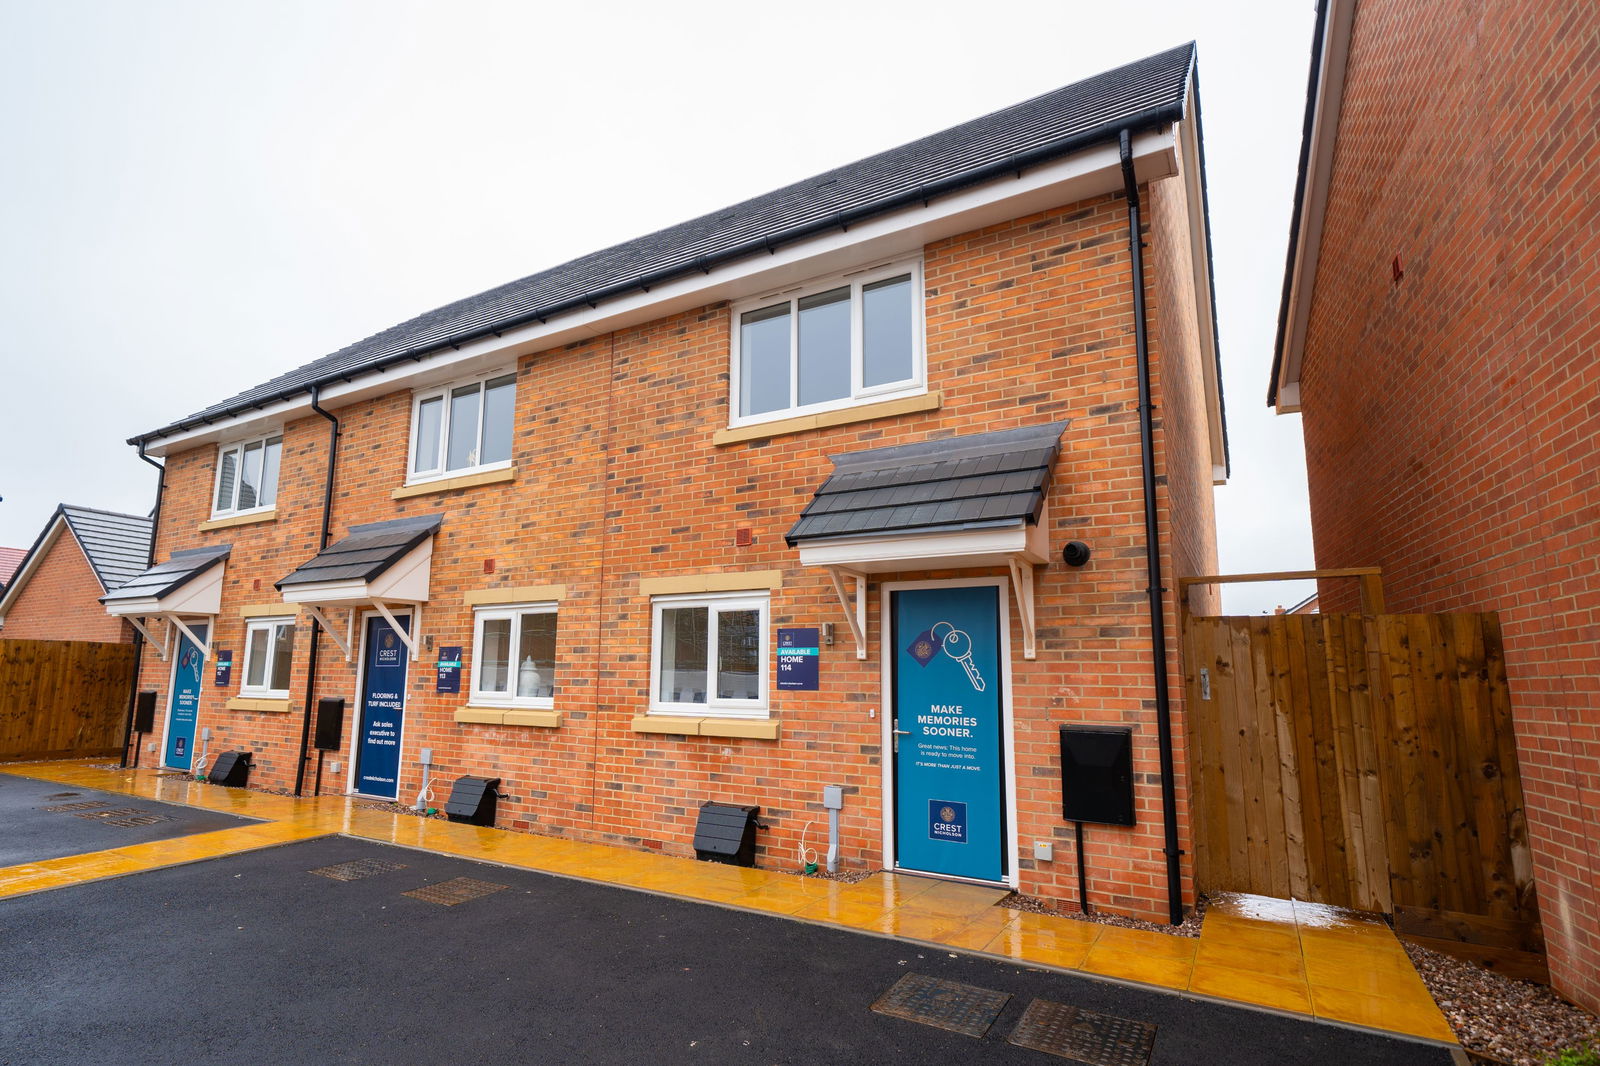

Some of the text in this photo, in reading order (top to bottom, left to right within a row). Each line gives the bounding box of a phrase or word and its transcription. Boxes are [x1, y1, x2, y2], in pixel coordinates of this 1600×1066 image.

[379, 649, 397, 657] CREST
[931, 704, 962, 714] MAKE
[918, 715, 977, 726] MEMORIES
[923, 726, 974, 738] SOONER.
[934, 822, 962, 832] CREST
